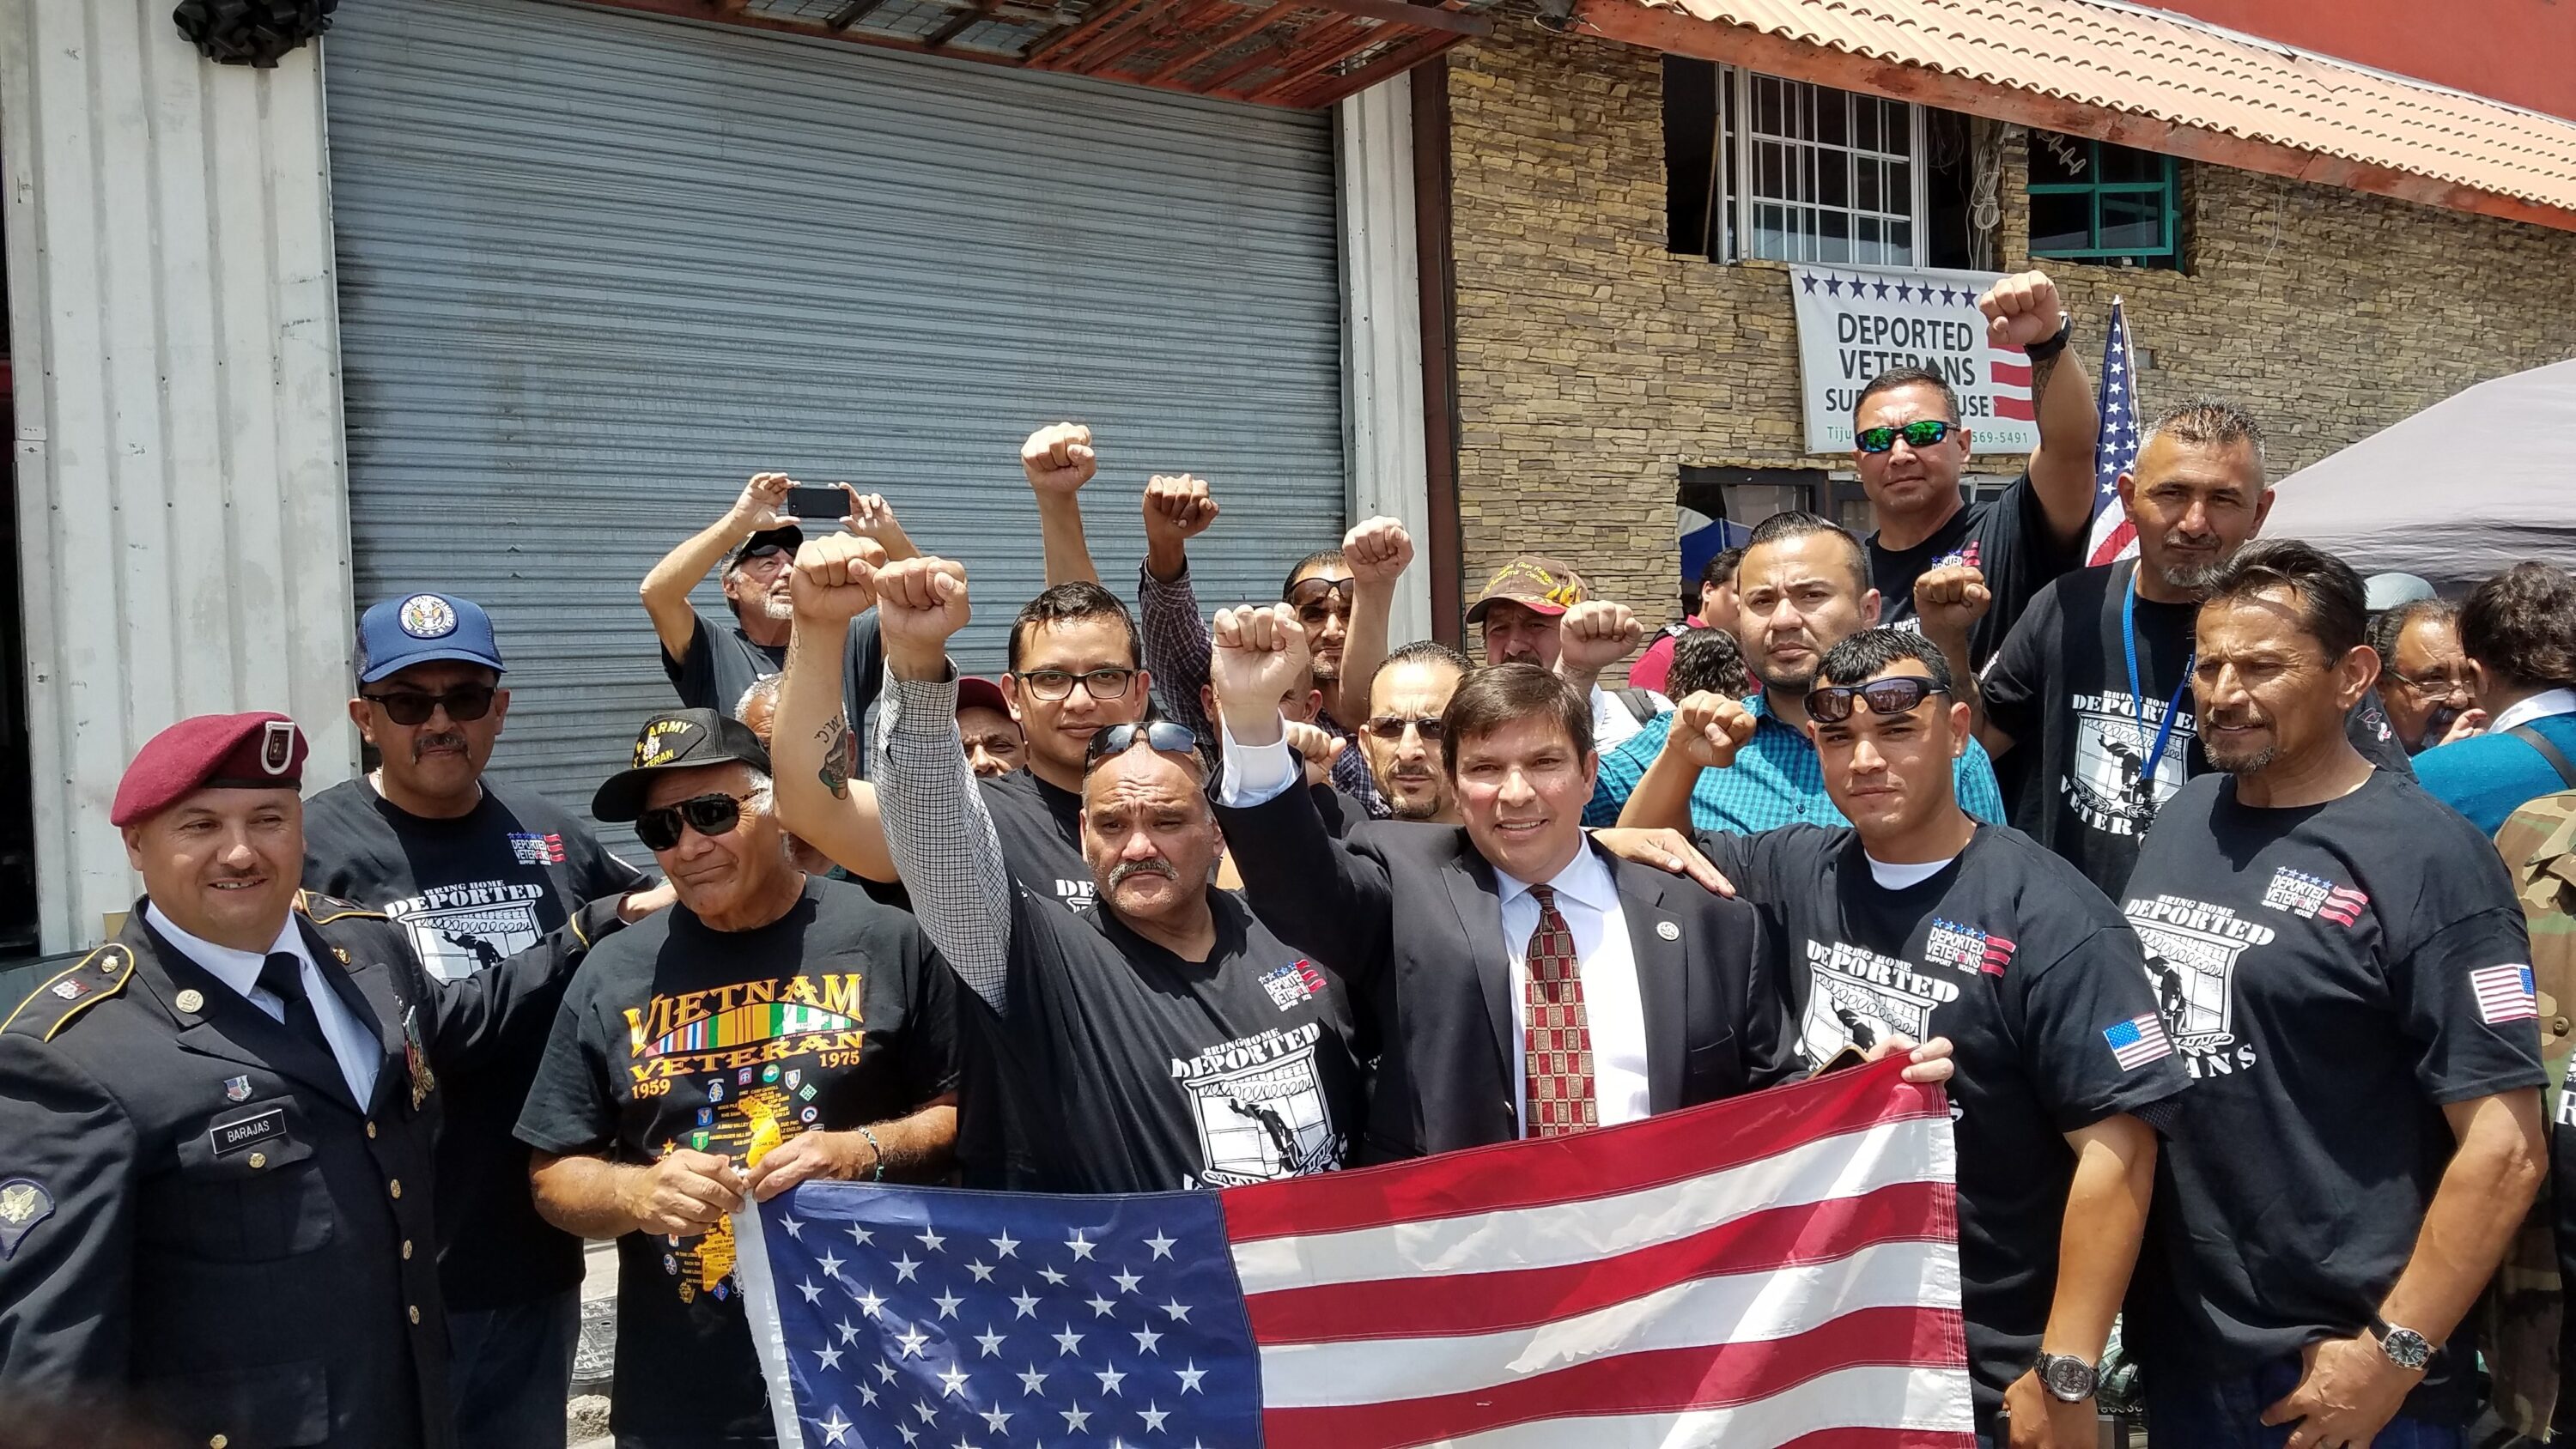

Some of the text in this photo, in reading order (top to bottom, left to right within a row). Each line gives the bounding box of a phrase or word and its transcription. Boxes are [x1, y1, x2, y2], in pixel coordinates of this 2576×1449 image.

[1838, 312, 1973, 352] DEPORTED
[1959, 394, 1990, 417] USE
[1827, 426, 1851, 442] Tiju
[2146, 697, 2170, 709] HOM
[648, 720, 693, 737] ARMY
[2061, 774, 2134, 837] VETER
[511, 840, 548, 851] DEPORTED
[514, 849, 550, 861] VETERANS
[423, 879, 505, 896] BRING HOME
[2265, 887, 2322, 912] VETERANS
[2269, 874, 2329, 901] DEPORTED
[384, 883, 544, 919] DEPORTED
[2157, 894, 2236, 919] BRING HOME
[2123, 899, 2275, 946] DEPORTED
[1929, 926, 1986, 955] DEPORTED
[1833, 941, 1913, 973] BRING HOME
[1924, 954, 1978, 976] SUPPORT HOUSE
[1926, 939, 1983, 969] VETERANS
[1807, 938, 1959, 1003] DEPORTED
[622, 973, 864, 1058] VIETNAM
[629, 1030, 866, 1082] VETERAN
[819, 1050, 860, 1069] 1975
[1171, 1022, 1321, 1078] DEPORTED
[1203, 1038, 1245, 1057] BRING
[631, 1078, 671, 1100] 1959
[227, 1120, 270, 1143] BARAJAS
